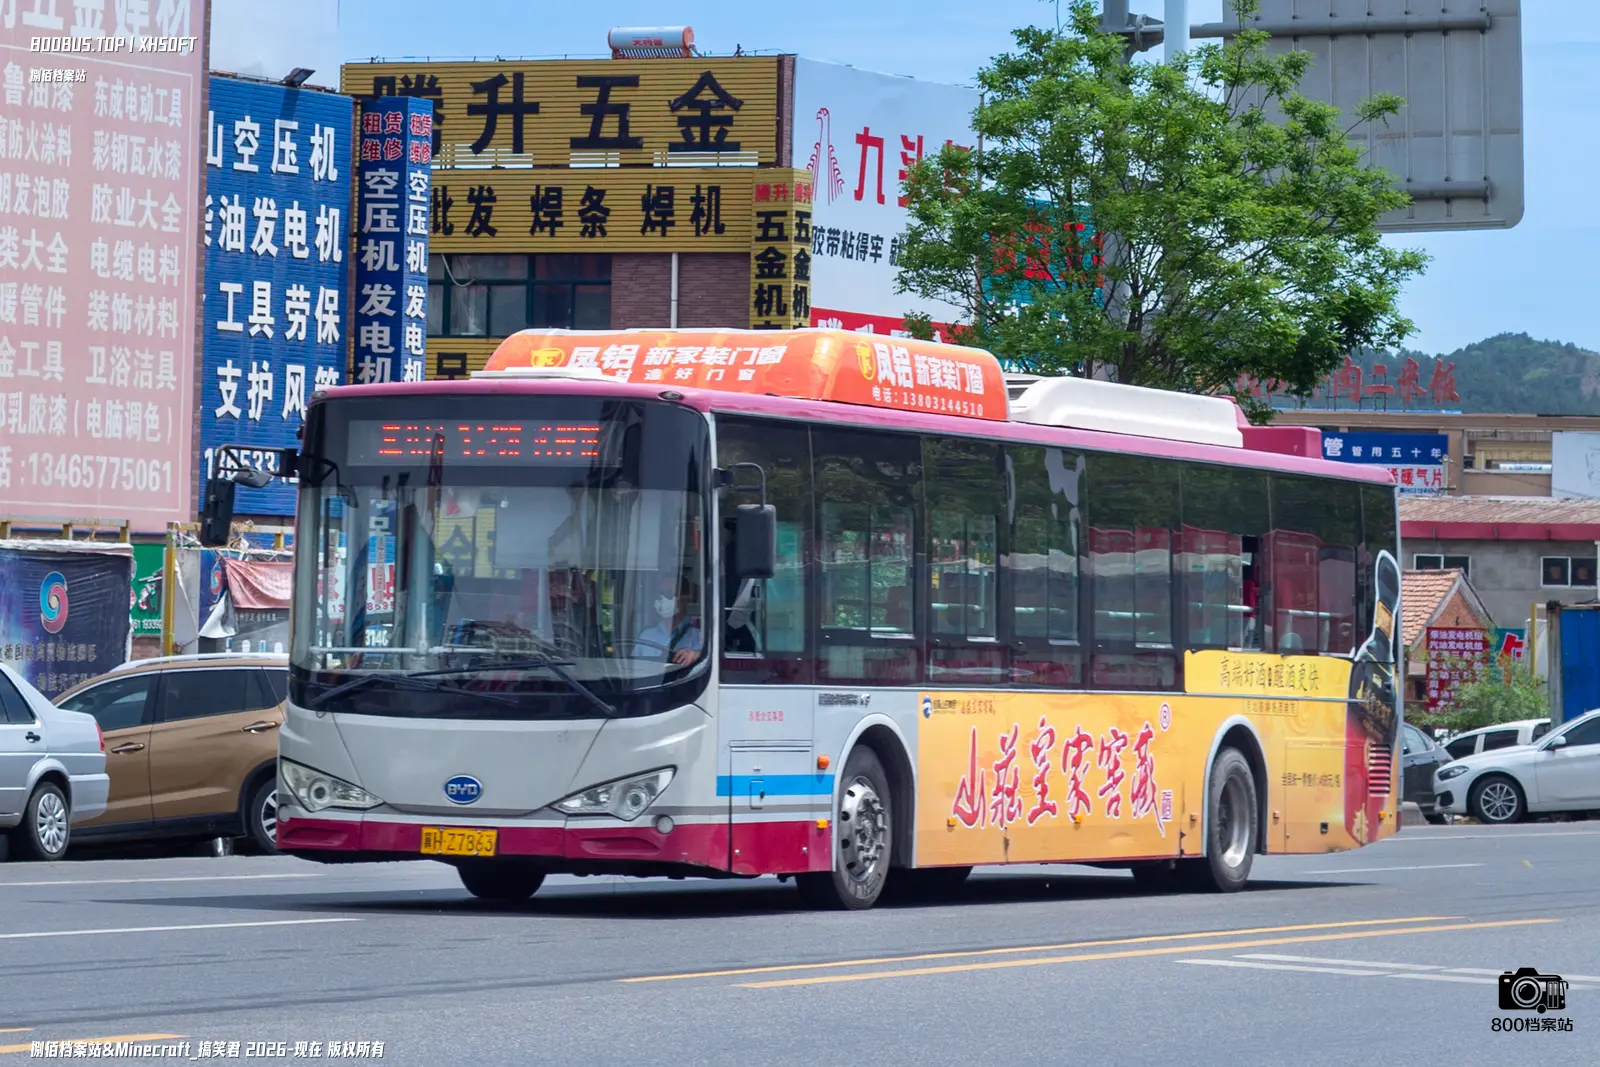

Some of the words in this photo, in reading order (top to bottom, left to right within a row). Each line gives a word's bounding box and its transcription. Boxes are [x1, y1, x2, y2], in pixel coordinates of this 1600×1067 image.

[93, 75, 183, 128] 东成电动工具
[363, 111, 403, 135] 租赁
[92, 130, 182, 181] 彩钢瓦水漆
[207, 110, 338, 182] 山空压机
[361, 138, 403, 161] 维修
[90, 183, 183, 233] 胶业大全
[431, 185, 498, 238] 批发
[529, 184, 612, 238] 焊条
[641, 184, 726, 238] 焊机
[0, 226, 68, 274] 类大全
[90, 236, 180, 286] 电缆电料
[792, 210, 811, 329] 五金机
[812, 225, 884, 265] 胶带粘得牢
[752, 211, 788, 329] 五金机
[87, 290, 179, 339] 装饰材料
[216, 281, 341, 344] 工具劳保
[86, 346, 177, 390] 卫浴洁具
[643, 346, 788, 366] 新家装门窗
[913, 353, 985, 395] 新家装门窗
[447, 783, 478, 795] BYD
